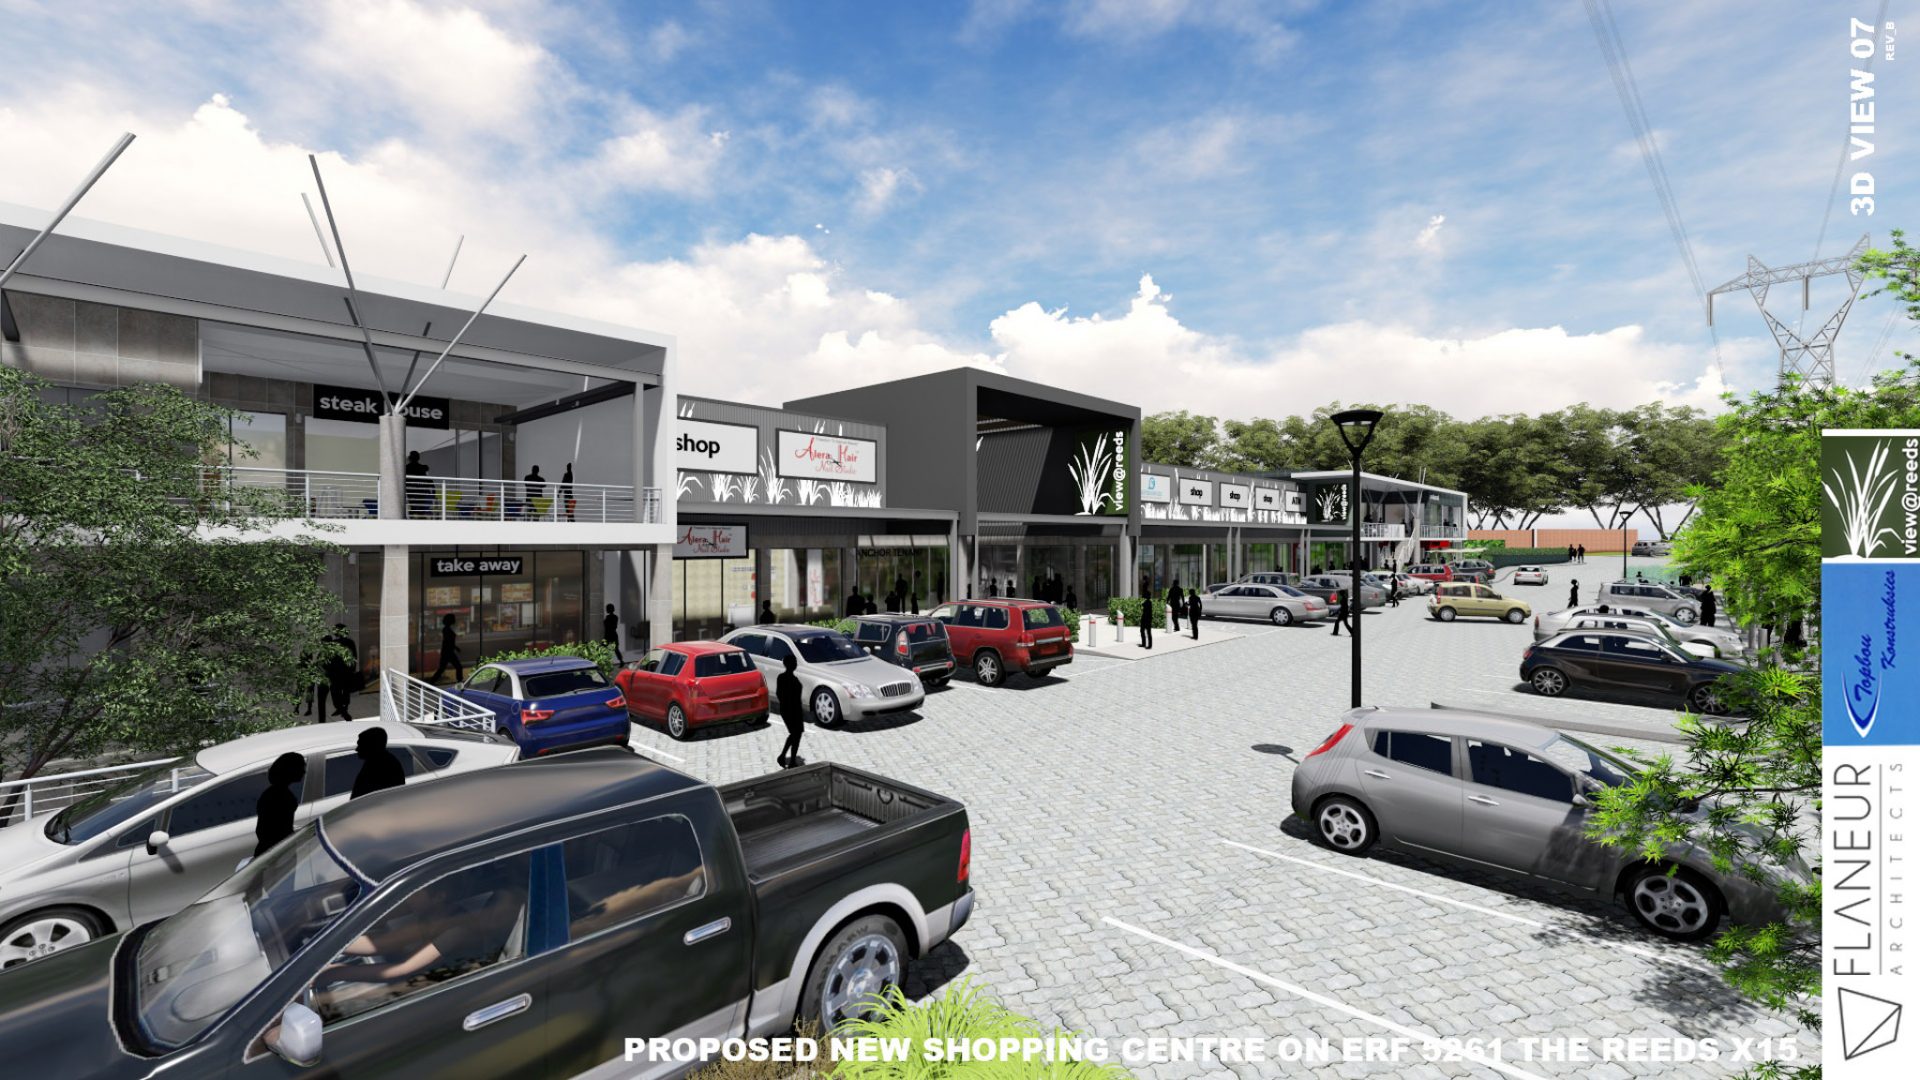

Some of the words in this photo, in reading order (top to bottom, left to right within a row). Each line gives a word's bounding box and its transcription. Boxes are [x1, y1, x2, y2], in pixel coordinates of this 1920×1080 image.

[319, 396, 378, 414] steak
[384, 401, 443, 420] ouse
[677, 433, 720, 459] shop
[838, 444, 857, 463] Hair
[1113, 431, 1126, 511] view@reeds
[1190, 486, 1203, 499] shop
[437, 558, 475, 573] take
[479, 559, 520, 574] away
